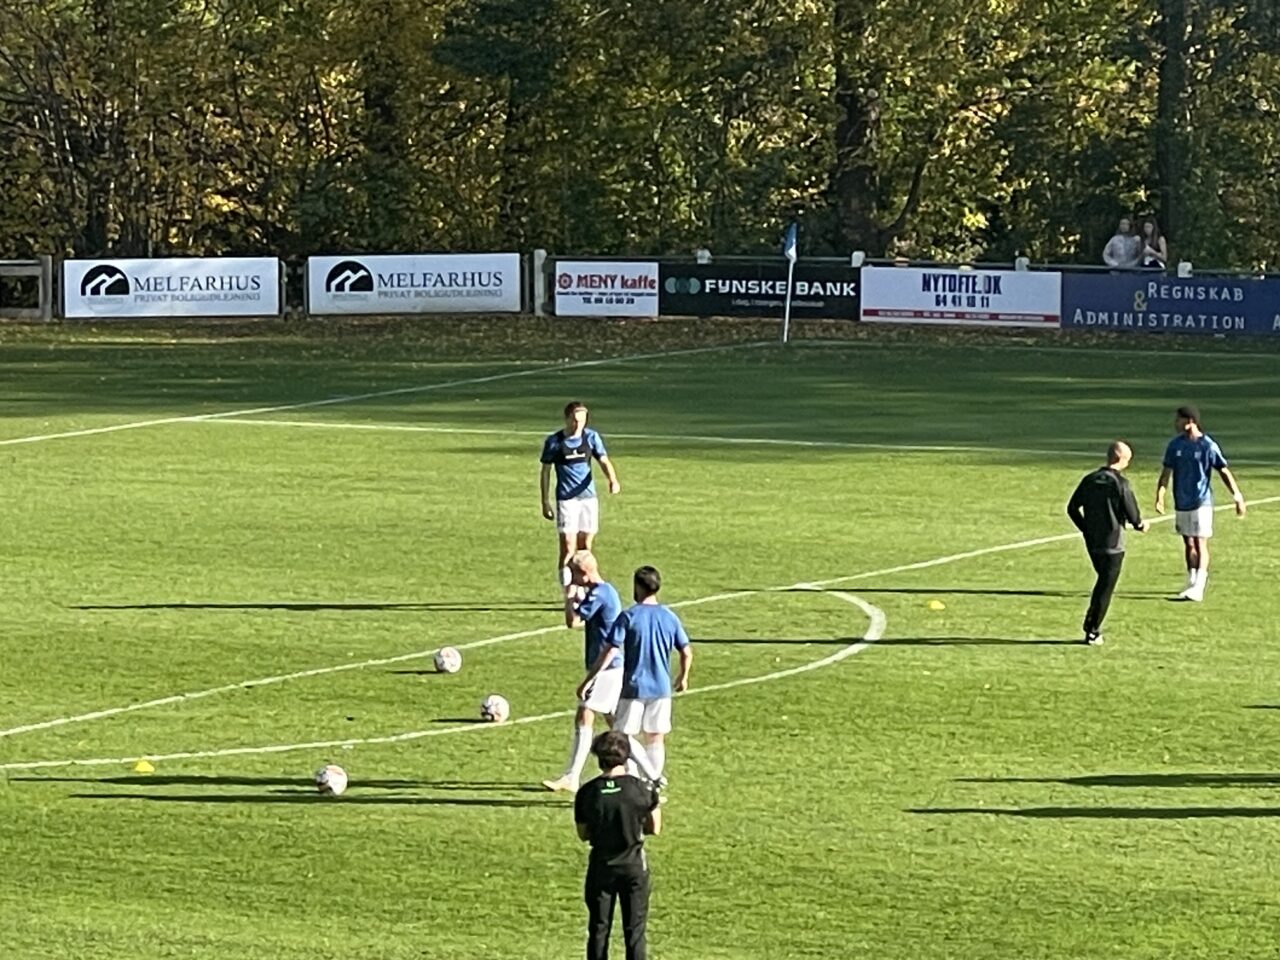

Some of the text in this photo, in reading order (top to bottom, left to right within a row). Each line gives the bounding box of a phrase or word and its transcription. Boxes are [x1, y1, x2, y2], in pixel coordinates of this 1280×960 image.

[133, 275, 261, 292] MELFARHUS
[377, 271, 503, 288] MELFARHUS
[576, 274, 657, 289] MENY kaffe
[704, 279, 856, 296] FYNSKE BANK
[922, 273, 1002, 295] NYTOFTE.DK
[134, 293, 169, 303] PRIVAT
[1133, 290, 1148, 311] &
[1148, 282, 1244, 302] REGNSKAB
[1073, 308, 1245, 330] ADMINISTRATION
